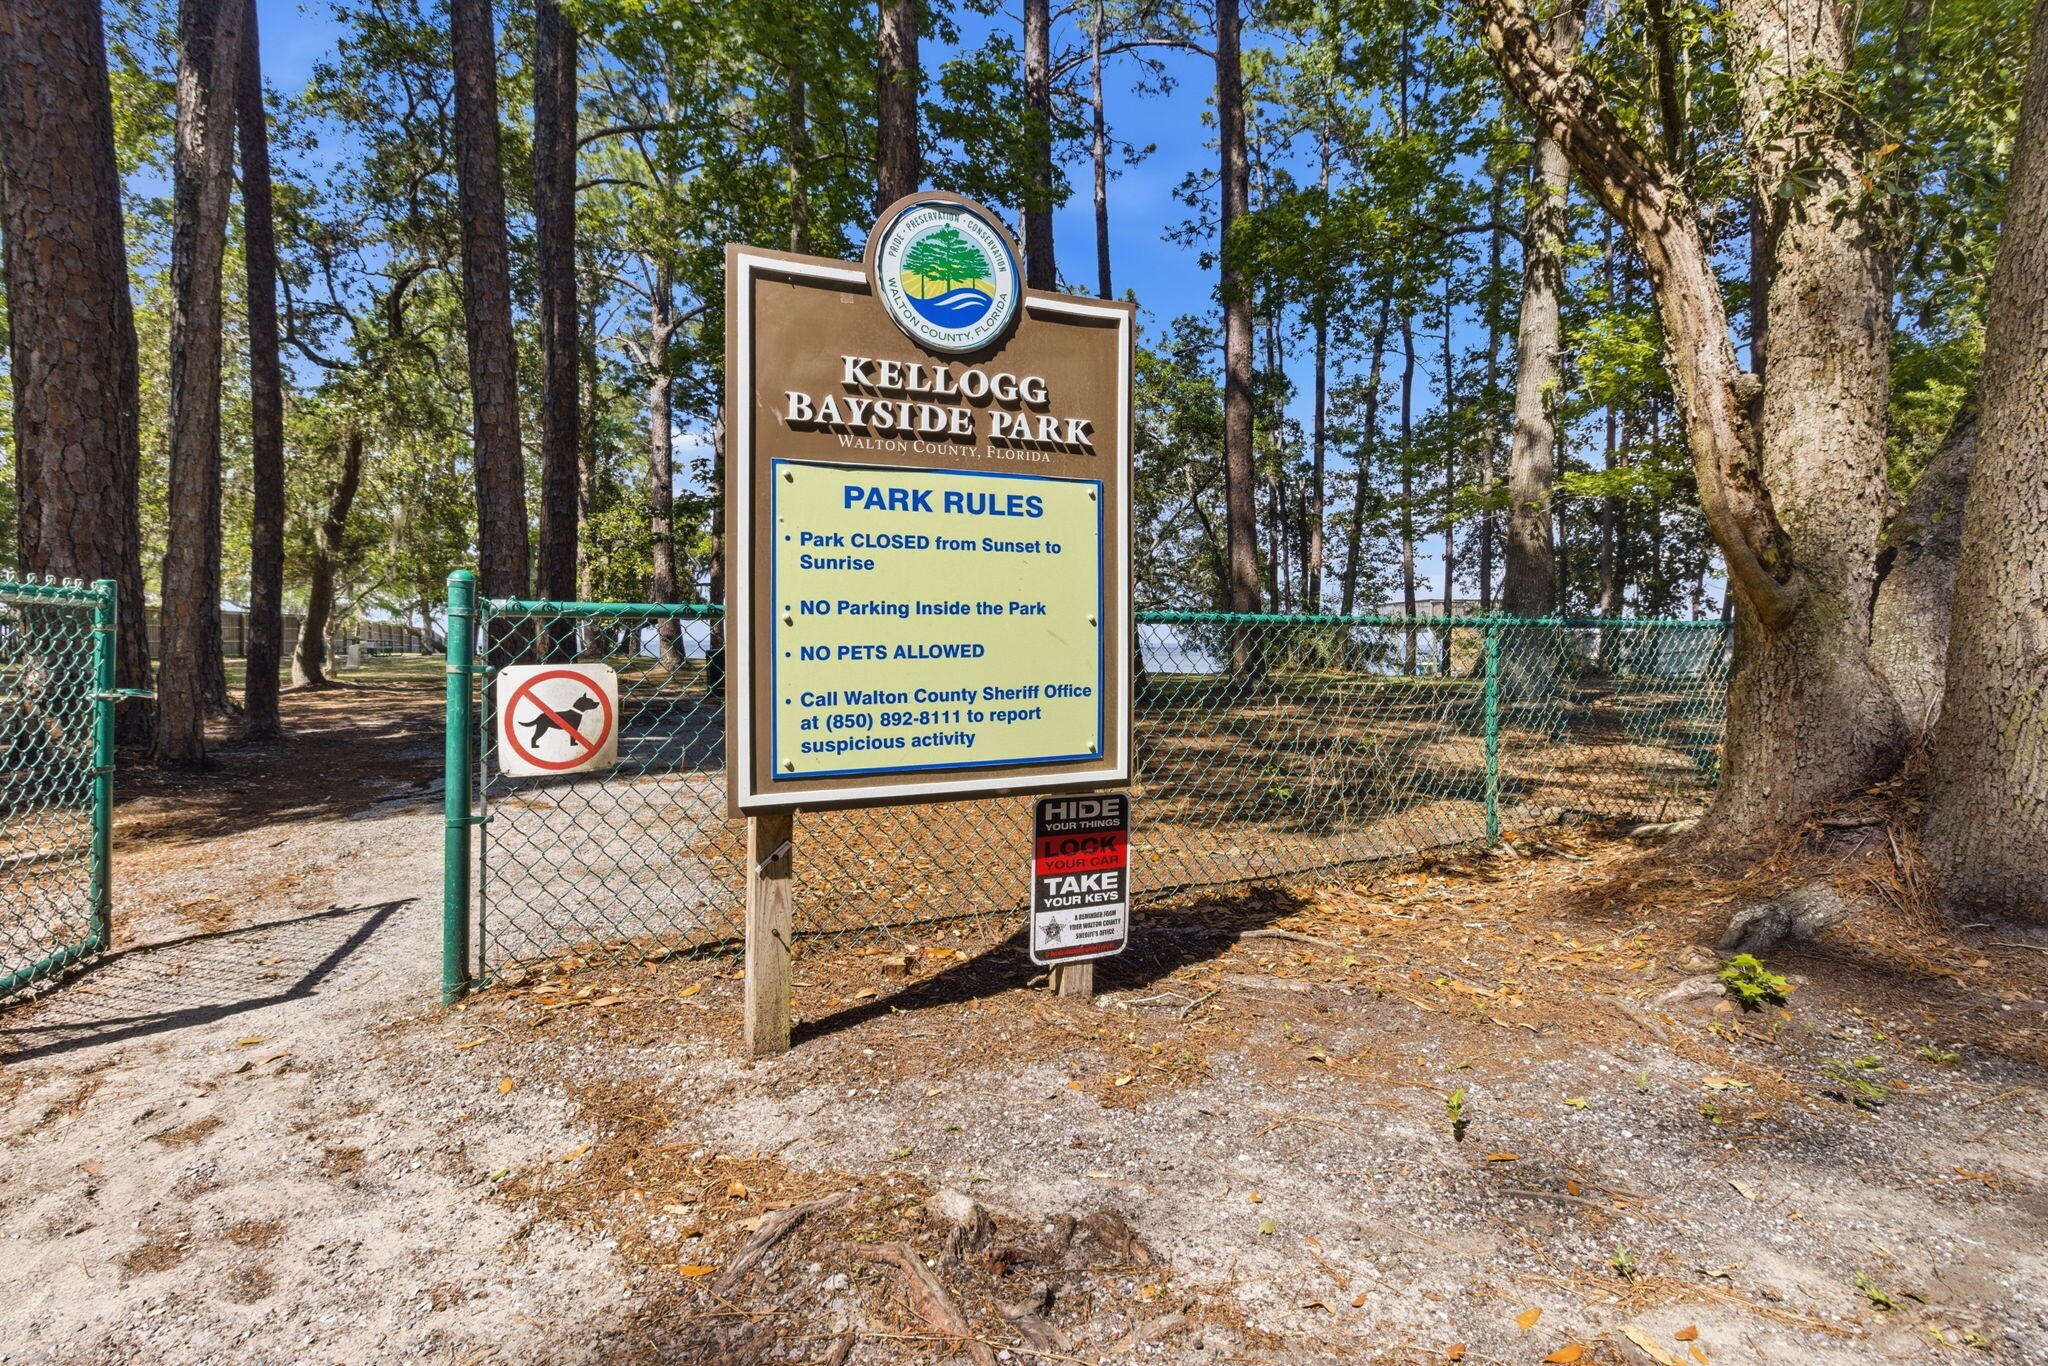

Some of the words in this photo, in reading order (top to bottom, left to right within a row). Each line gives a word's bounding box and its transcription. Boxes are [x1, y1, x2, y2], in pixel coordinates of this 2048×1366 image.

[888, 234, 904, 257] PRIDE
[906, 212, 960, 231] PRESERVATION
[967, 221, 1007, 272] CONSERVATION
[889, 278, 919, 327] WALTON
[921, 324, 973, 341] COUNTY,
[976, 293, 1007, 336] FLORIDA
[840, 355, 1047, 403] KELLOGG
[784, 391, 972, 435] BAYSIDE
[988, 410, 1092, 445] PARK
[838, 434, 907, 453] WALTON
[913, 440, 981, 459] COUNTY,
[987, 446, 1051, 462] FLORIDA
[844, 486, 933, 512] PARK
[944, 490, 1043, 518] RULES
[801, 532, 844, 547] Park
[851, 533, 930, 549] CLOSED
[935, 536, 976, 550] from
[982, 538, 1041, 553] Sunset
[1045, 540, 1061, 554] to
[800, 554, 874, 570] Sunrise
[801, 600, 830, 615] NO
[837, 601, 909, 618] Parking
[916, 601, 970, 615] Inside
[976, 602, 1003, 615] the
[1009, 602, 1046, 615] Park
[801, 646, 830, 660] NO
[837, 645, 887, 660] PETS
[893, 644, 984, 658] ALLOWED
[801, 692, 838, 707] Call
[844, 690, 908, 706] Walton
[914, 688, 977, 705] County
[982, 686, 1039, 700] Sheriff
[1044, 684, 1092, 698] Office
[801, 716, 819, 730] at
[826, 714, 873, 732] (850)
[880, 710, 960, 727] 892-8111
[967, 710, 984, 723] to
[989, 707, 1041, 724] report
[801, 734, 905, 755] suspicious
[911, 732, 976, 747] activity
[1045, 799, 1119, 820] HIDE
[1046, 822, 1077, 831] YOUR
[1080, 819, 1120, 828] THINGS
[1045, 836, 1117, 857] LOCK
[1045, 858, 1085, 870] YOUR
[1090, 855, 1118, 865] CAR
[1044, 872, 1118, 895] TAKE
[1044, 896, 1081, 907] YOUR
[1085, 891, 1118, 903] KEYS
